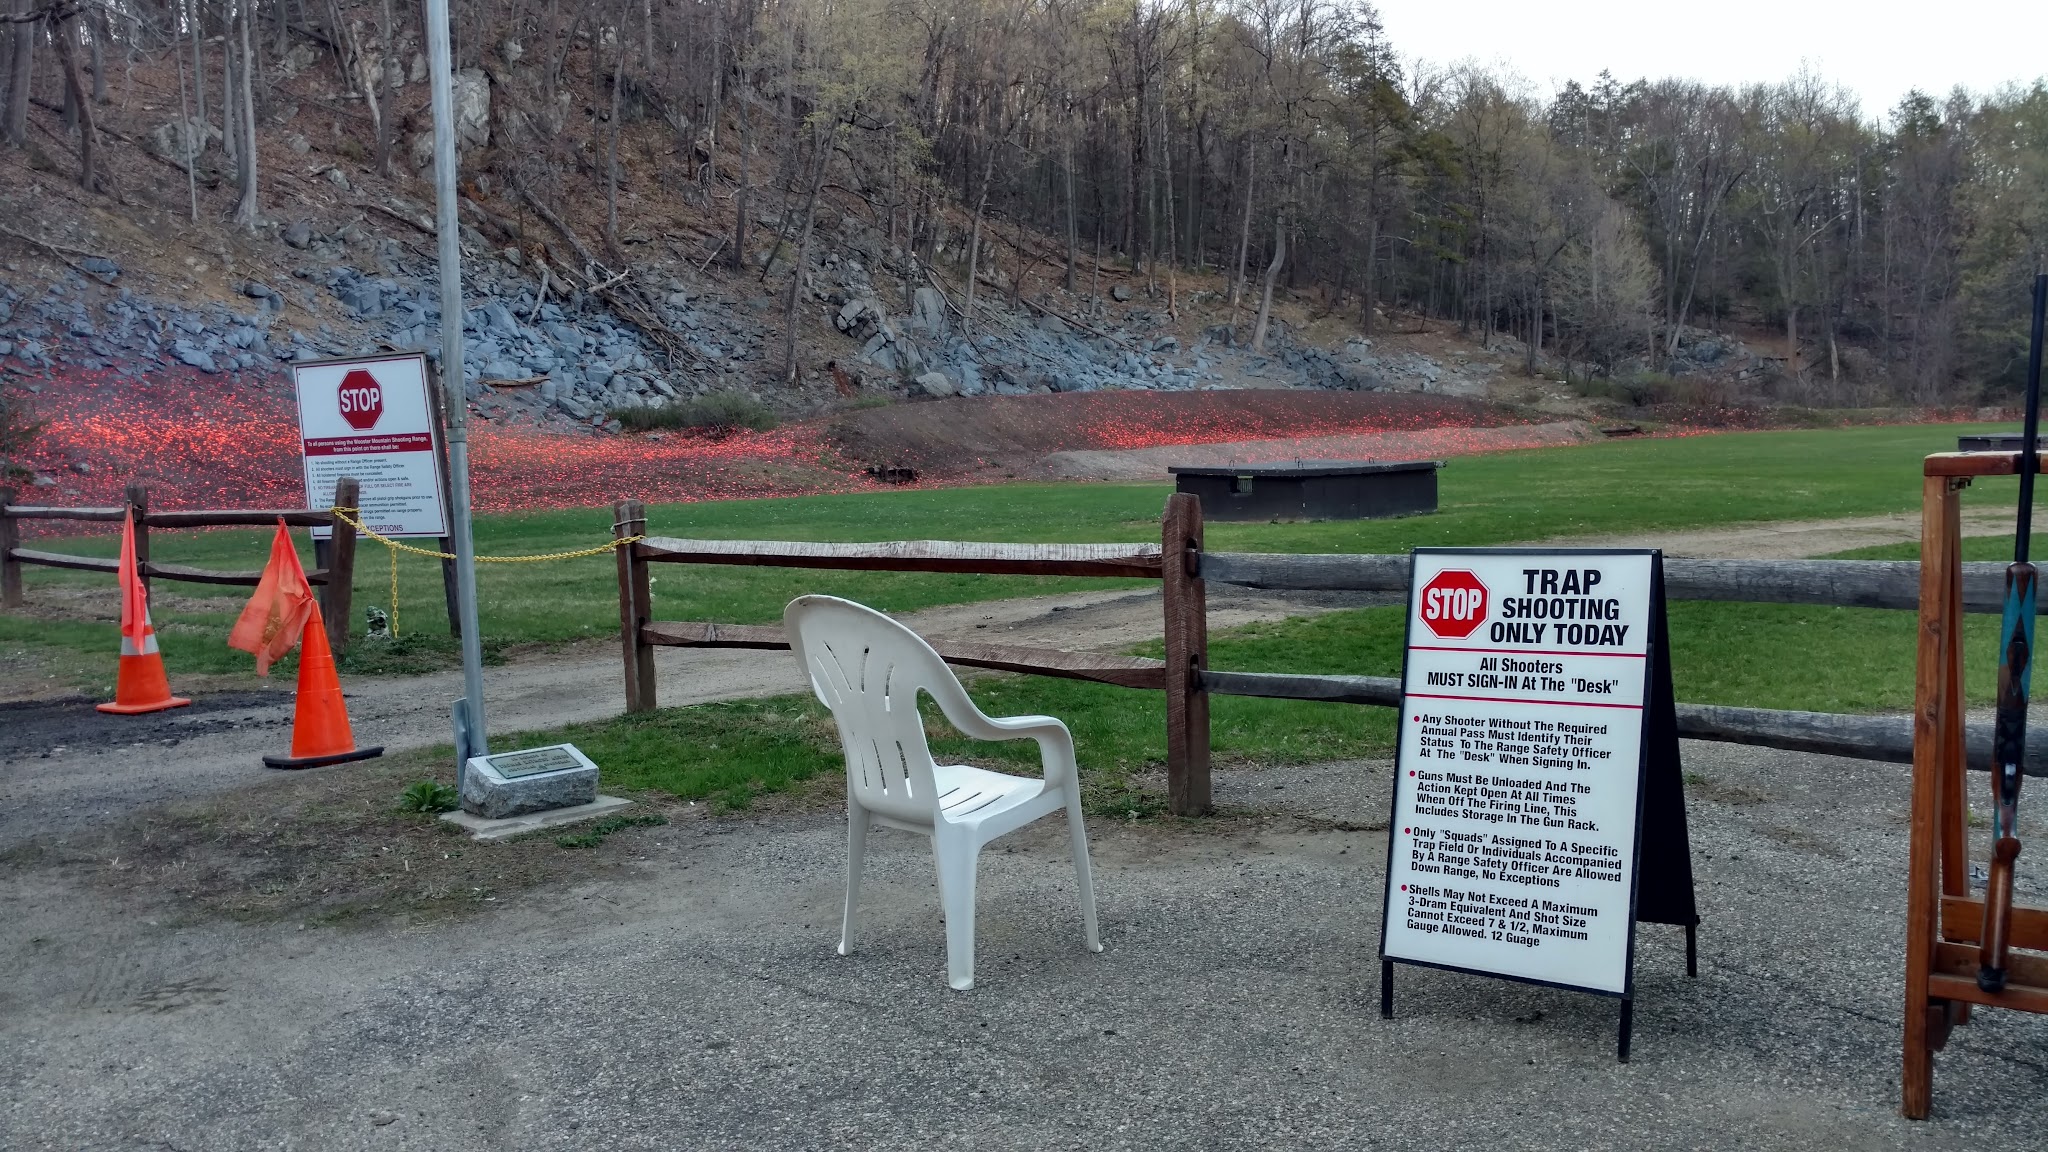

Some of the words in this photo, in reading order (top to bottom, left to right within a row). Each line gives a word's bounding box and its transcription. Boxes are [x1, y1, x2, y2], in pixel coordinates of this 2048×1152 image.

[340, 387, 380, 413] STOP
[366, 524, 404, 532] XCEPTIONS
[1522, 569, 1601, 595] TRAP
[1426, 587, 1482, 621] STOP
[1503, 598, 1619, 620] SHOOTING
[1491, 622, 1546, 644] ONLY
[1553, 623, 1628, 646] TODAY
[1480, 657, 1497, 671] All
[1502, 658, 1563, 674] Shooters
[1428, 672, 1464, 687] MUST
[1468, 673, 1517, 689] SIGN-IN
[1522, 676, 1536, 690] At
[1540, 676, 1565, 691] The
[1571, 678, 1618, 693] "Desk"
[1421, 726, 1457, 737] Annual
[1461, 728, 1485, 739] Pass
[1489, 730, 1515, 741] Must
[1518, 731, 1560, 745] Identify
[1564, 734, 1592, 746] Their
[1423, 714, 1441, 726] Any
[1445, 715, 1485, 727] Shooter
[1489, 718, 1531, 730] Without
[1534, 720, 1553, 731] The
[1558, 722, 1607, 734] Required
[1420, 748, 1430, 758] At
[1437, 749, 1455, 760] The
[1460, 751, 1494, 763] "Desk"
[1499, 754, 1528, 765] When
[1533, 756, 1573, 770] Signing
[1577, 760, 1590, 770] In.
[1421, 737, 1454, 749] Status
[1460, 739, 1471, 750] To
[1474, 740, 1493, 751] The
[1497, 742, 1529, 754] Range
[1534, 744, 1568, 757] Safety
[1572, 746, 1611, 759] Officer
[1418, 770, 1443, 782] Guns
[1447, 772, 1472, 784] Must
[1476, 775, 1488, 786] Be
[1492, 776, 1542, 790] Unloaded
[1545, 780, 1567, 792] And
[1571, 782, 1590, 794] The
[1418, 782, 1450, 794] Action
[1454, 785, 1477, 797] Kept
[1481, 787, 1507, 799] Open
[1511, 789, 1522, 800] At
[1525, 790, 1539, 802] All
[1542, 792, 1575, 805] Times
[1416, 804, 1458, 818] Includes
[1462, 808, 1503, 823] Storage
[1507, 813, 1516, 823] In
[1520, 814, 1539, 826] The
[1544, 816, 1564, 828] Gun
[1568, 818, 1599, 831] Rack.
[1417, 793, 1445, 805] When
[1449, 796, 1464, 807] Off
[1467, 797, 1486, 809] The
[1490, 799, 1520, 813] Firing
[1525, 802, 1550, 815] Line,
[1554, 805, 1577, 817] This
[1413, 839, 1435, 852] Trap
[1439, 841, 1463, 853] Field
[1467, 844, 1479, 855] Or
[1482, 846, 1541, 861] Individuals
[1545, 852, 1621, 870] Accompanied
[1414, 827, 1435, 840] Only
[1440, 829, 1487, 844] "Squads"
[1492, 834, 1542, 849] Assigned
[1545, 840, 1556, 851] To
[1560, 841, 1568, 852] A
[1572, 842, 1618, 857] Specific
[1412, 861, 1440, 874] Down
[1444, 865, 1479, 879] Range,
[1483, 869, 1496, 880] No
[1500, 871, 1560, 887] Exceptions
[1413, 850, 1424, 862] By
[1428, 852, 1435, 862] A
[1438, 853, 1470, 866] Range
[1474, 856, 1508, 871] Safety
[1512, 860, 1549, 874] Officer
[1553, 865, 1572, 877] Are
[1576, 867, 1621, 882] Allowed
[1409, 896, 1446, 910] 3-Dram
[1450, 901, 1506, 917] Equivalent
[1509, 908, 1530, 920] And
[1534, 911, 1559, 924] Shot
[1563, 915, 1586, 928] Size
[1410, 884, 1440, 897] Shells
[1444, 888, 1464, 902] May
[1468, 891, 1486, 903] Not
[1490, 894, 1528, 908] Exceed
[1531, 899, 1539, 909] A
[1543, 900, 1598, 917] Maximum
[1407, 919, 1439, 933] Gauge
[1442, 923, 1487, 938] Allowed.
[1491, 929, 1502, 940] 12
[1507, 931, 1540, 947] Guage
[1408, 907, 1444, 921] Cannot
[1447, 912, 1485, 927] Exceed
[1488, 918, 1495, 928] 7
[1498, 919, 1506, 930] &
[1510, 920, 1529, 934] 1/2,
[1533, 923, 1588, 940] Maximum
